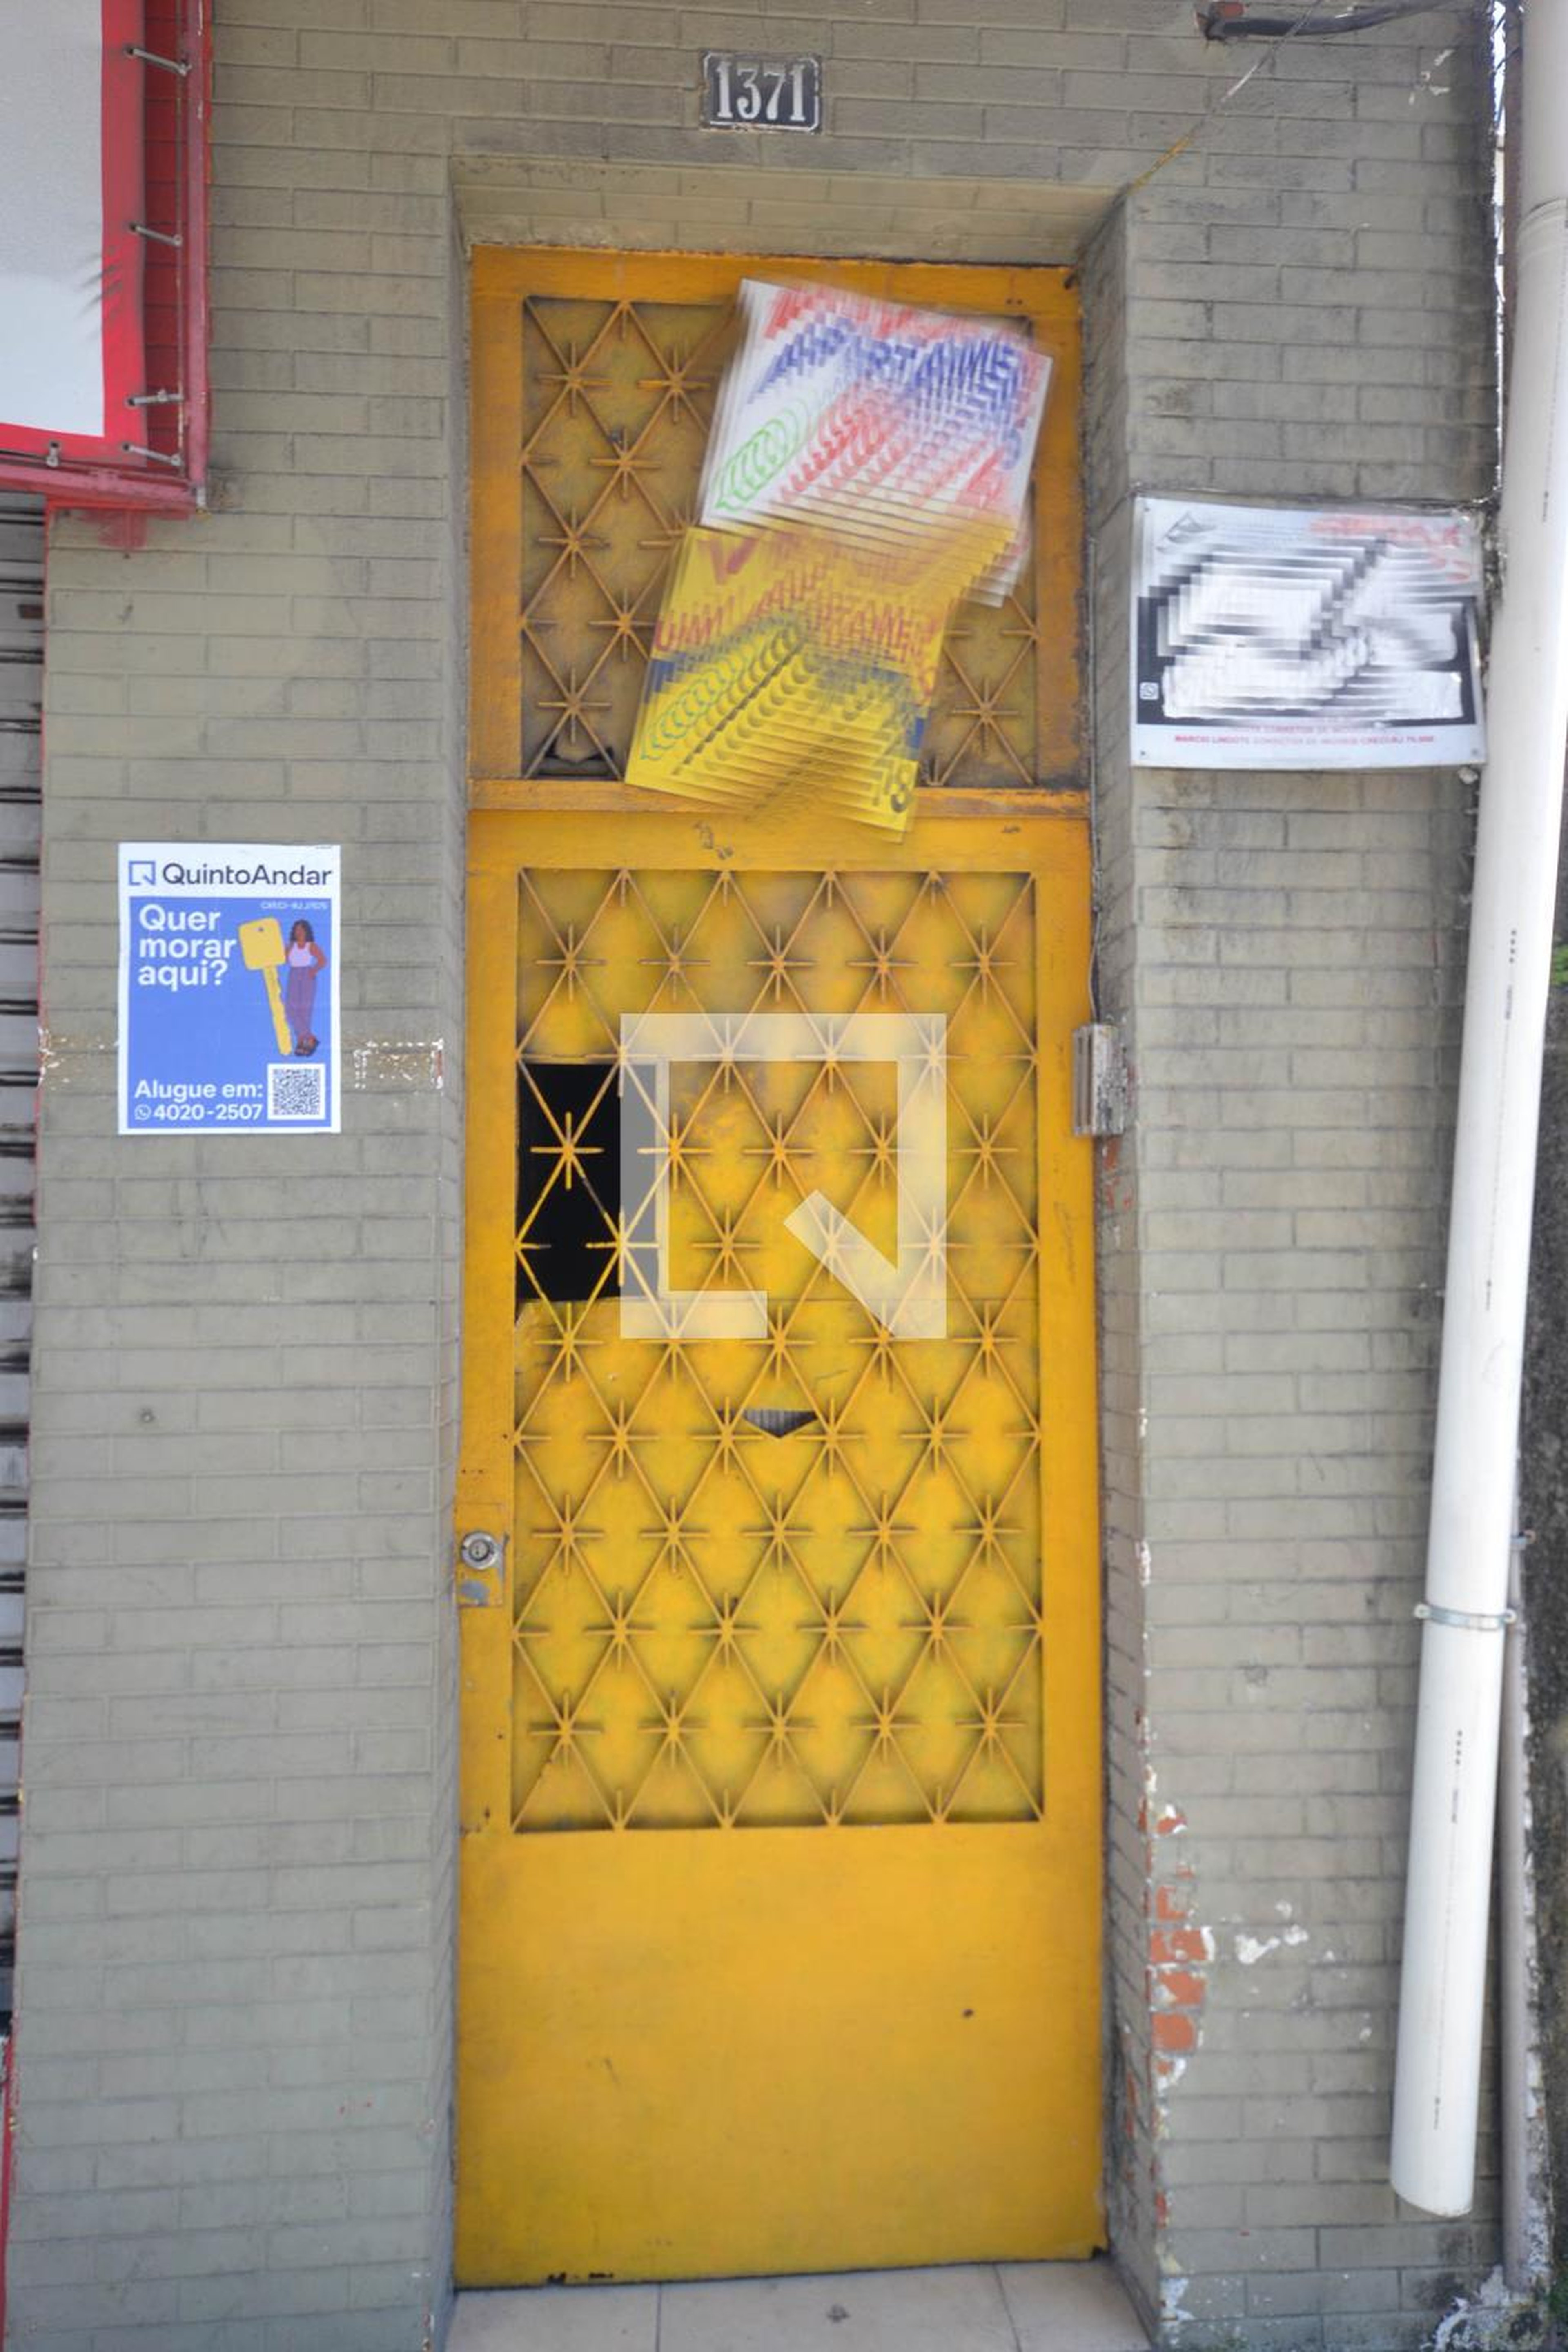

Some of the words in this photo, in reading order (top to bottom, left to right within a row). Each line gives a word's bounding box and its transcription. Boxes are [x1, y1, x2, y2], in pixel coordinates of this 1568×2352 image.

[716, 60, 806, 122] 1371
[163, 863, 332, 886] QuintoAndar
[139, 904, 221, 931] Quer
[140, 938, 236, 960] morar
[138, 960, 228, 992] aqui?
[135, 1079, 217, 1103] Alugue
[222, 1083, 263, 1098] em:
[154, 1105, 263, 1120] 4020-2507
